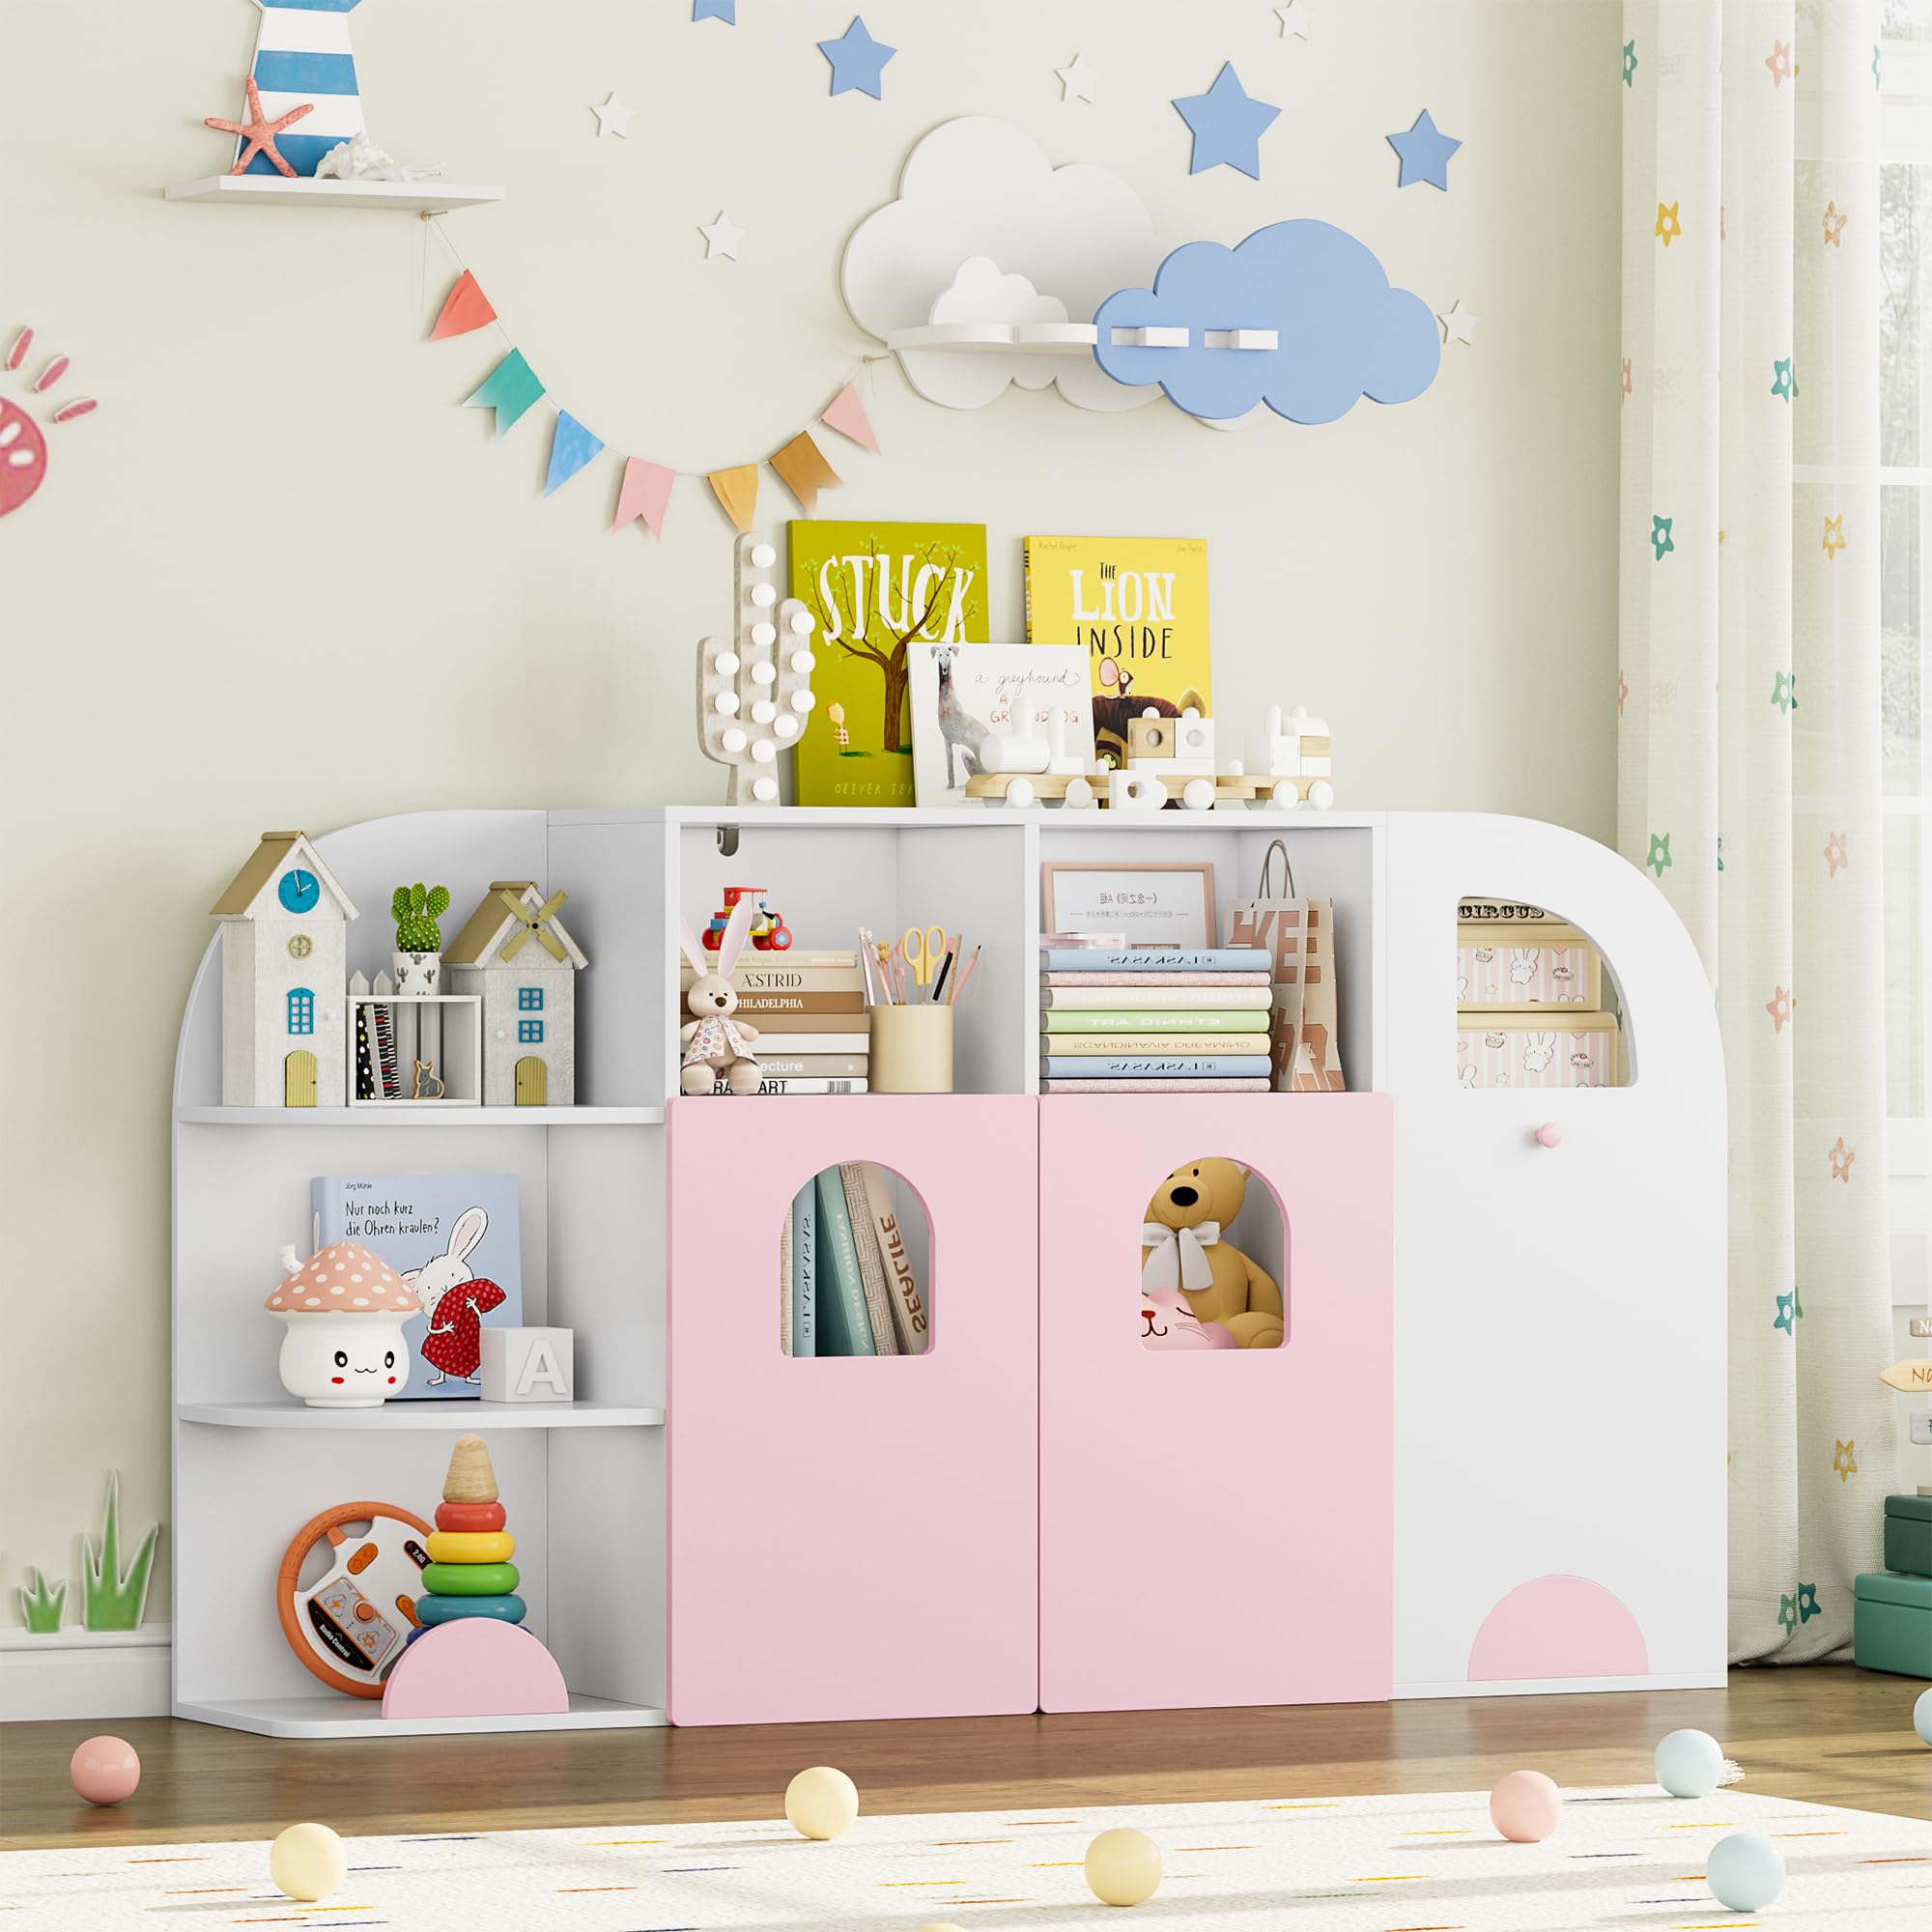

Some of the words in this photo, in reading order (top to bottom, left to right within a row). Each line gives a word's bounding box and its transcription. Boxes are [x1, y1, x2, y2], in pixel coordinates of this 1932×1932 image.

[1099, 562, 1117, 580] THE
[820, 554, 975, 646] STUCK
[1069, 569, 1176, 621] LION
[1077, 624, 1174, 658] INSIDE
[995, 668, 1081, 696] greyhound
[999, 694, 1009, 706] A
[834, 782, 881, 796] OLIVER
[1458, 905, 1545, 919] CIRCUS
[757, 1081, 787, 1094] ART
[346, 1201, 364, 1216] Nur
[367, 1200, 391, 1214] noch
[394, 1200, 414, 1215] kurz
[346, 1220, 361, 1236] die
[364, 1220, 395, 1236] Ohren
[399, 1217, 440, 1236] kraulen?
[514, 1338, 568, 1396] A
